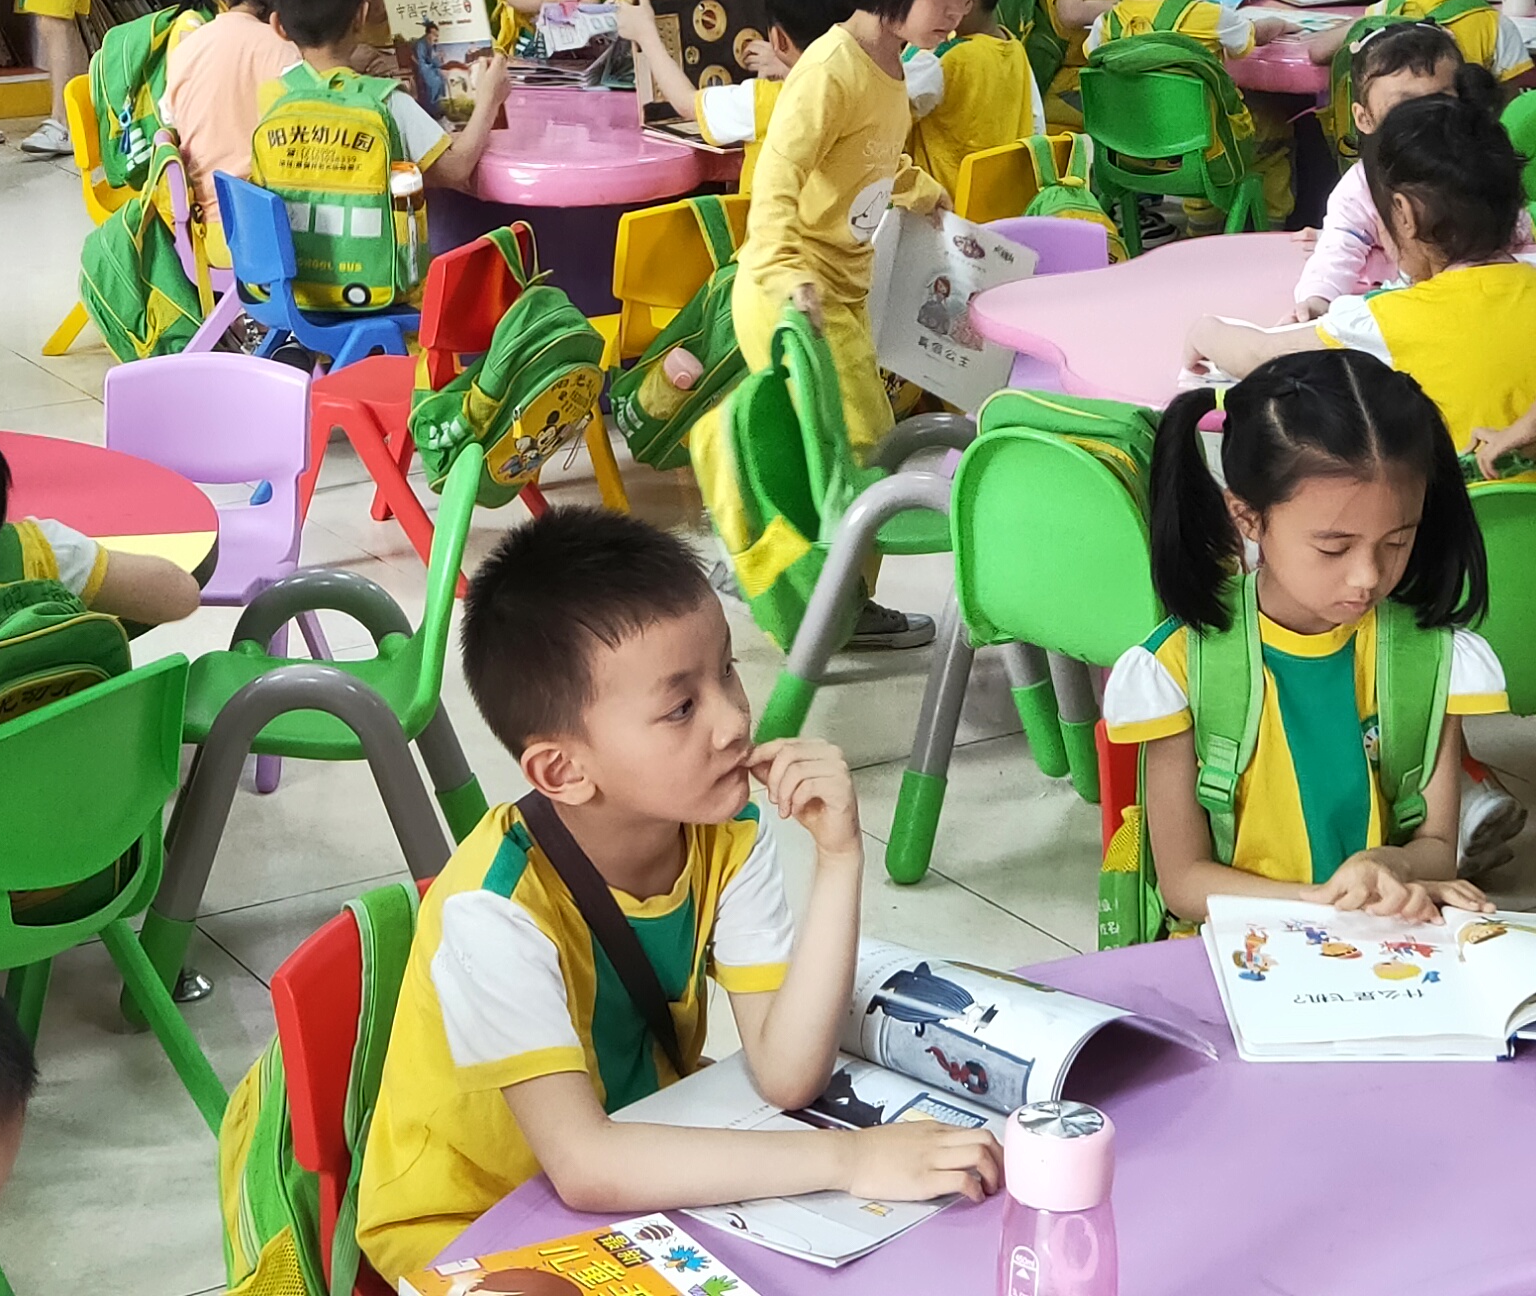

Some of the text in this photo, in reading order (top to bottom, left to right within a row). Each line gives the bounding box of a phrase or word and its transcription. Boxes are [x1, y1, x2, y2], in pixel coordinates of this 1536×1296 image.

[267, 124, 375, 153] 阳光幼儿园
